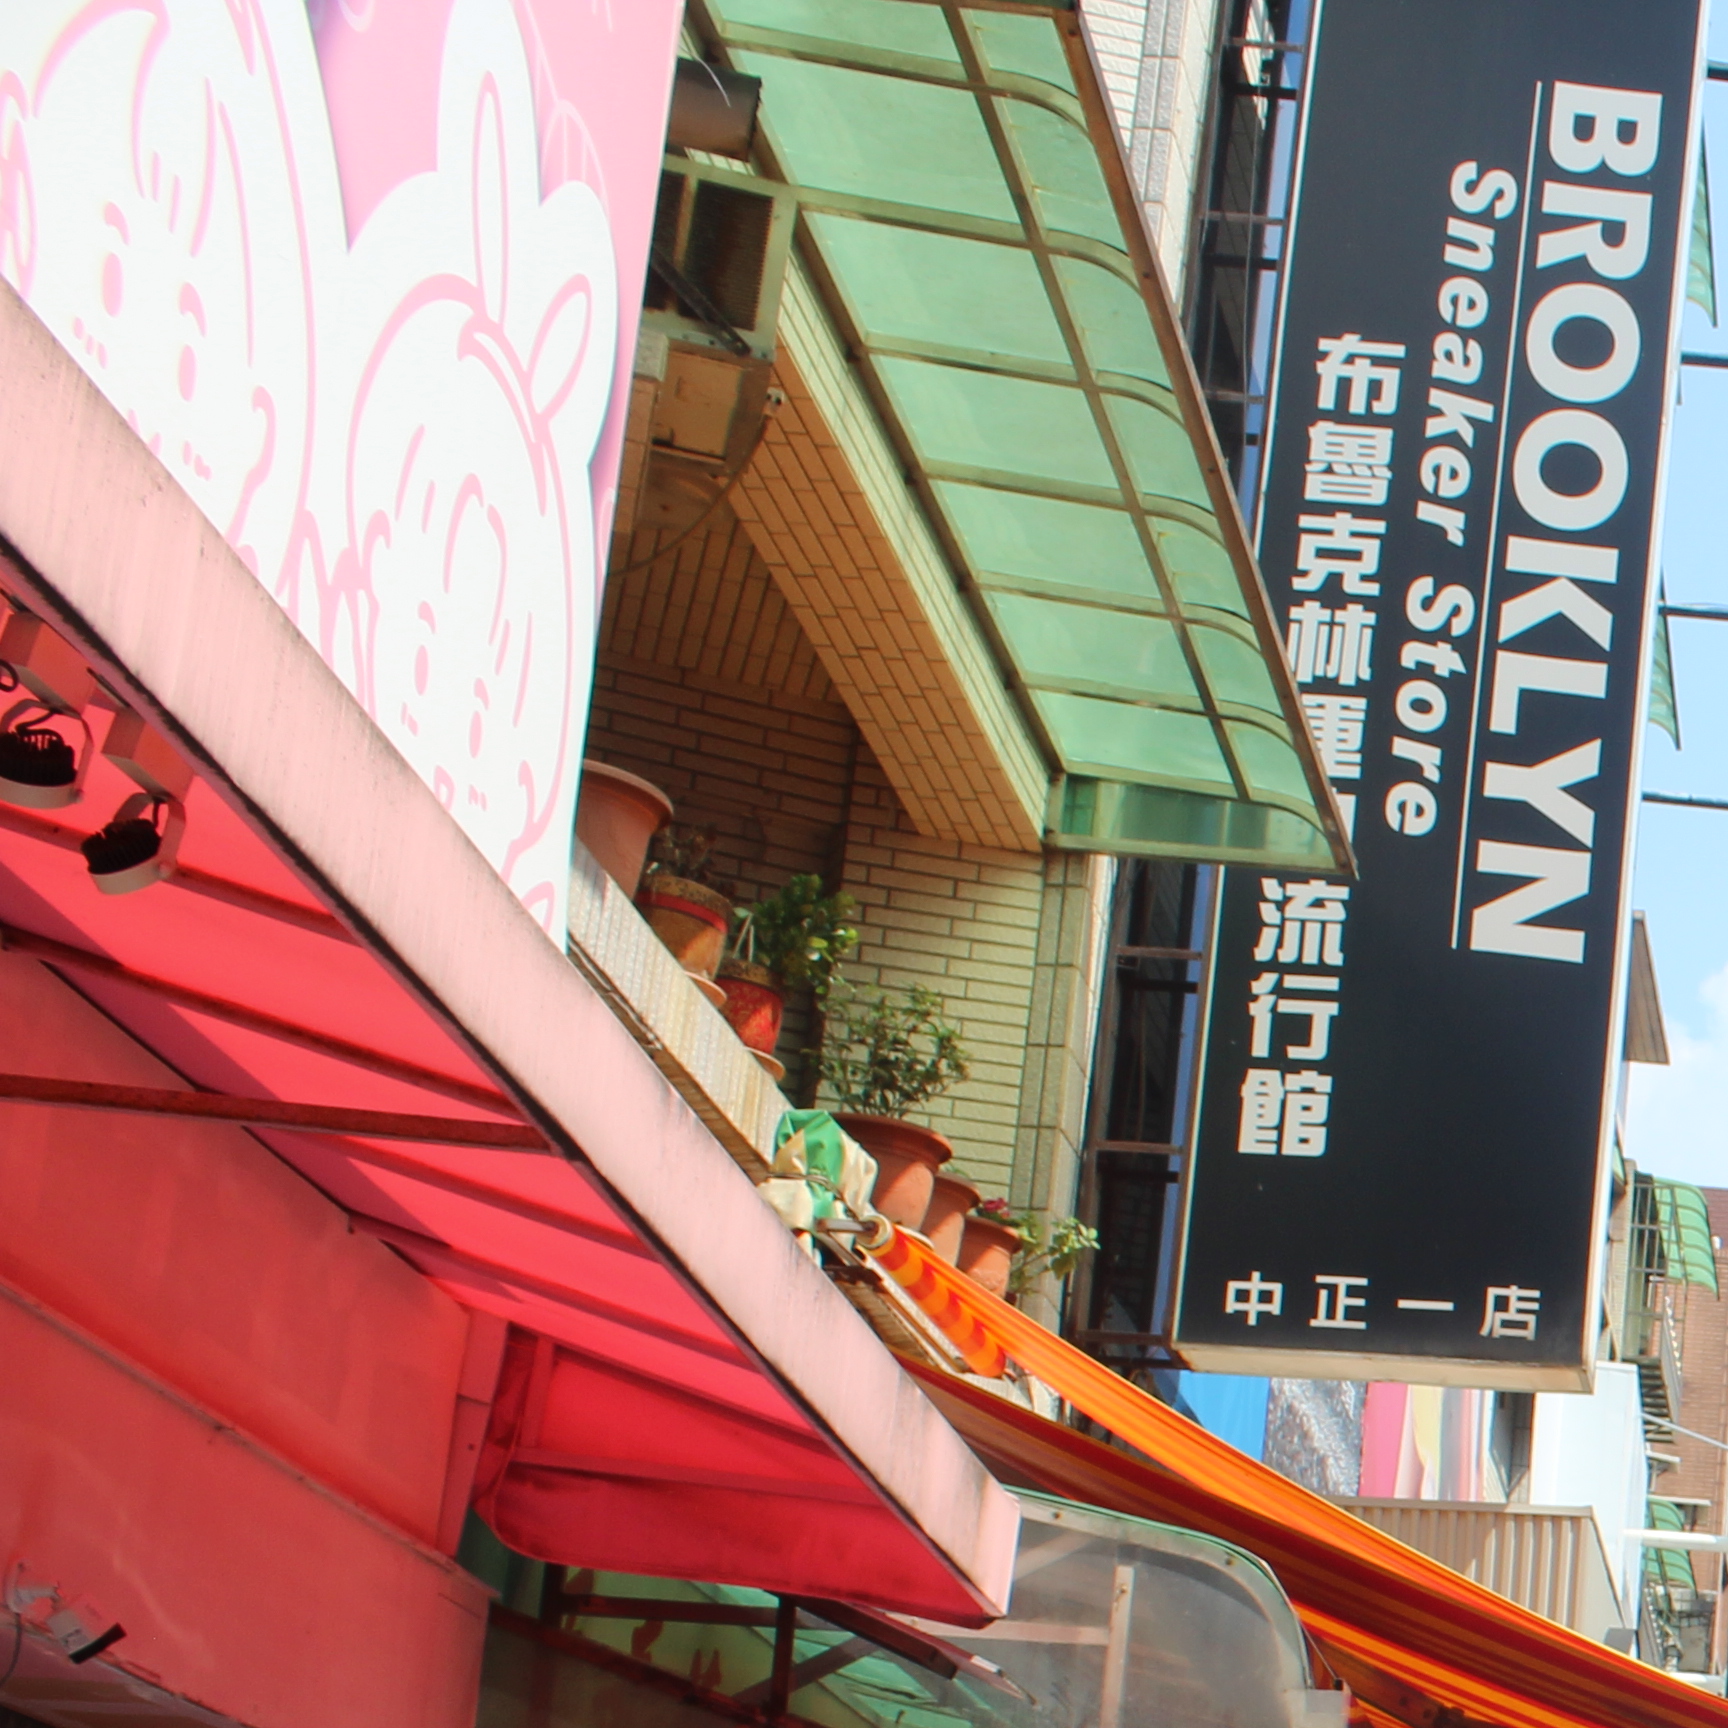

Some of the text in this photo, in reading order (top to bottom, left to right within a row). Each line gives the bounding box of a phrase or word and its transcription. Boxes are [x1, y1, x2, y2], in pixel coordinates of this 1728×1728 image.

[1238, 333, 1407, 1158] 布魯克林運流行館
[1386, 160, 1518, 838] Sneaker Store
[1470, 82, 1662, 964] BROOKLYN
[1223, 1270, 1542, 1341] 中正一店
